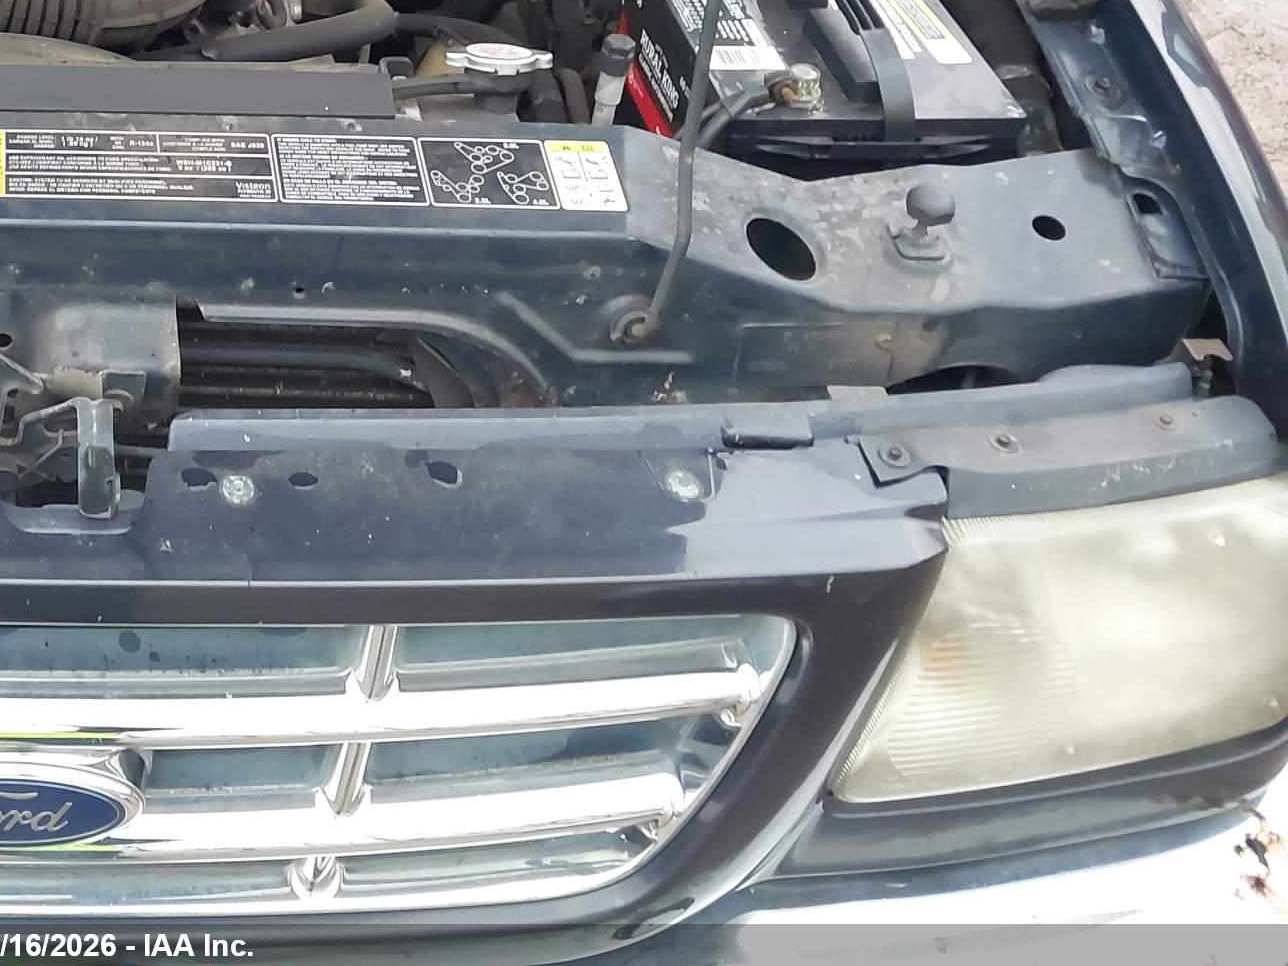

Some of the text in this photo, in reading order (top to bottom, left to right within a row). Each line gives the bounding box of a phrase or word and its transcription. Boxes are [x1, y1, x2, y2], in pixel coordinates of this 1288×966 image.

[639, 28, 663, 84] RURAL
[661, 69, 680, 110] KING
[235, 181, 271, 191] Visteon
